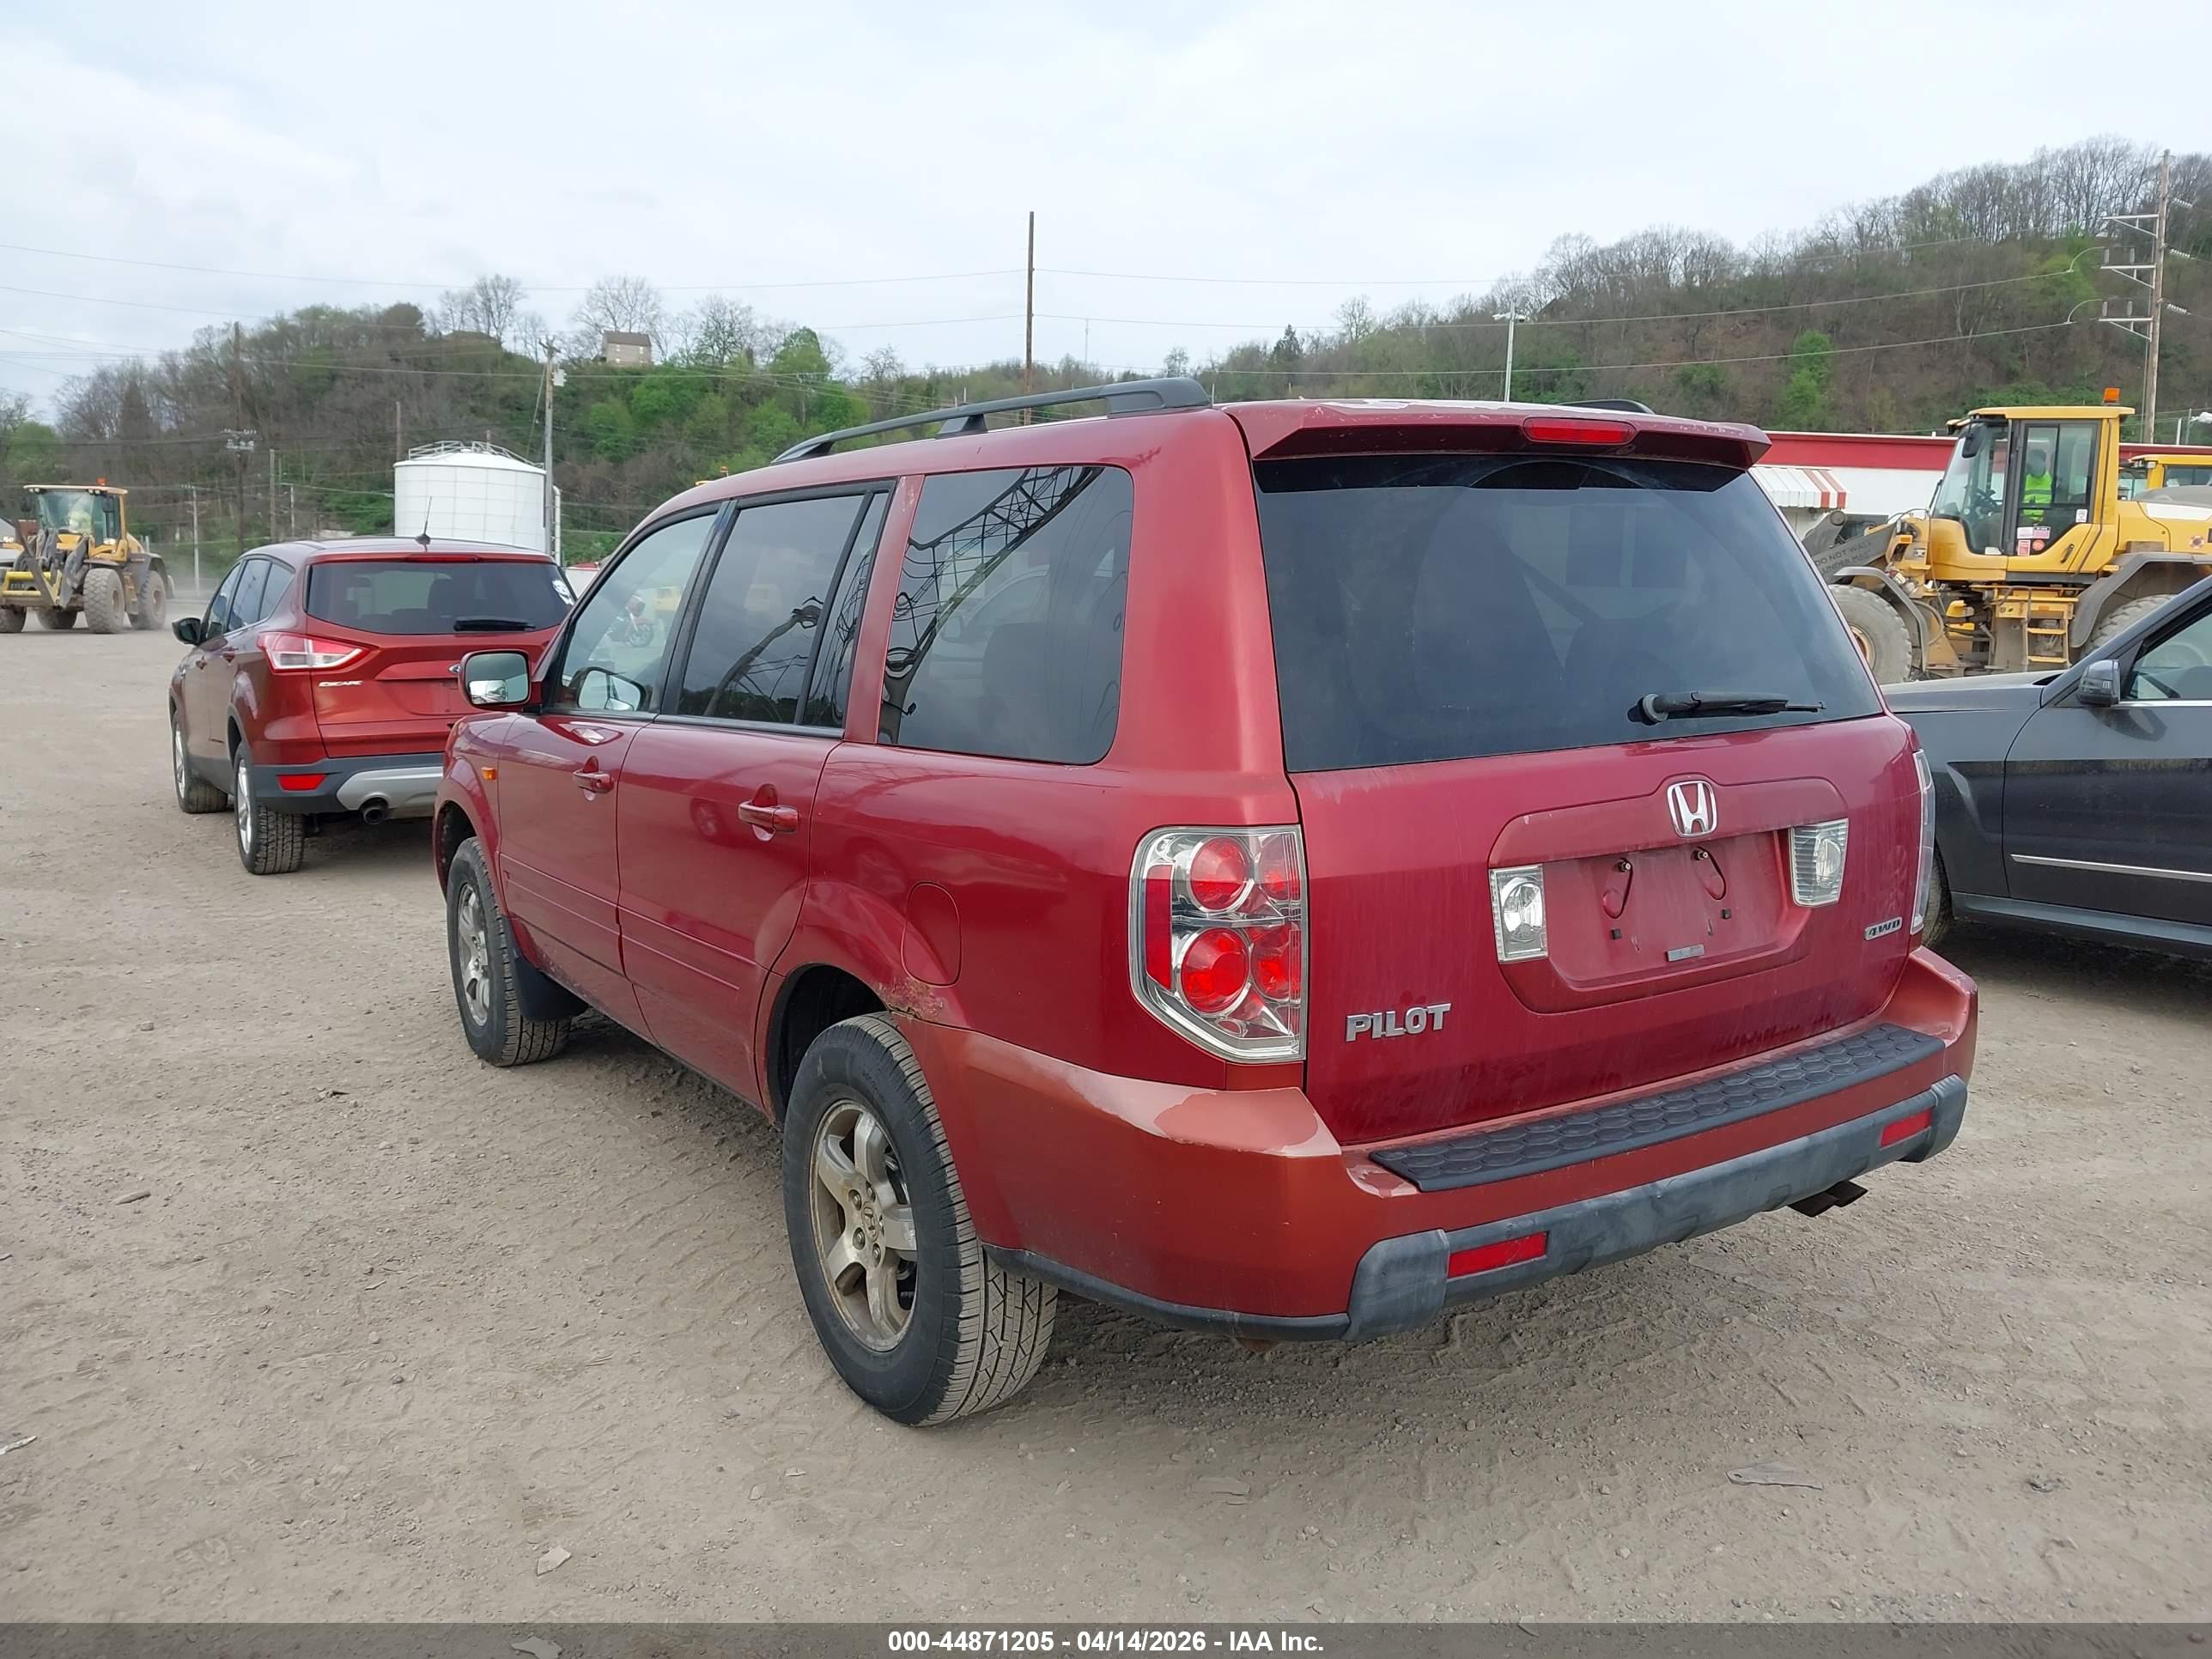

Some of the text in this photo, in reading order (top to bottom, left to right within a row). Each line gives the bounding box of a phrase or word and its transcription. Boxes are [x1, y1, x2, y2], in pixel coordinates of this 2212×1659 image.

[1829, 550, 1847, 561] NOT
[1868, 919, 1900, 936] 4WD
[1346, 1003, 1451, 1042] PILOT
